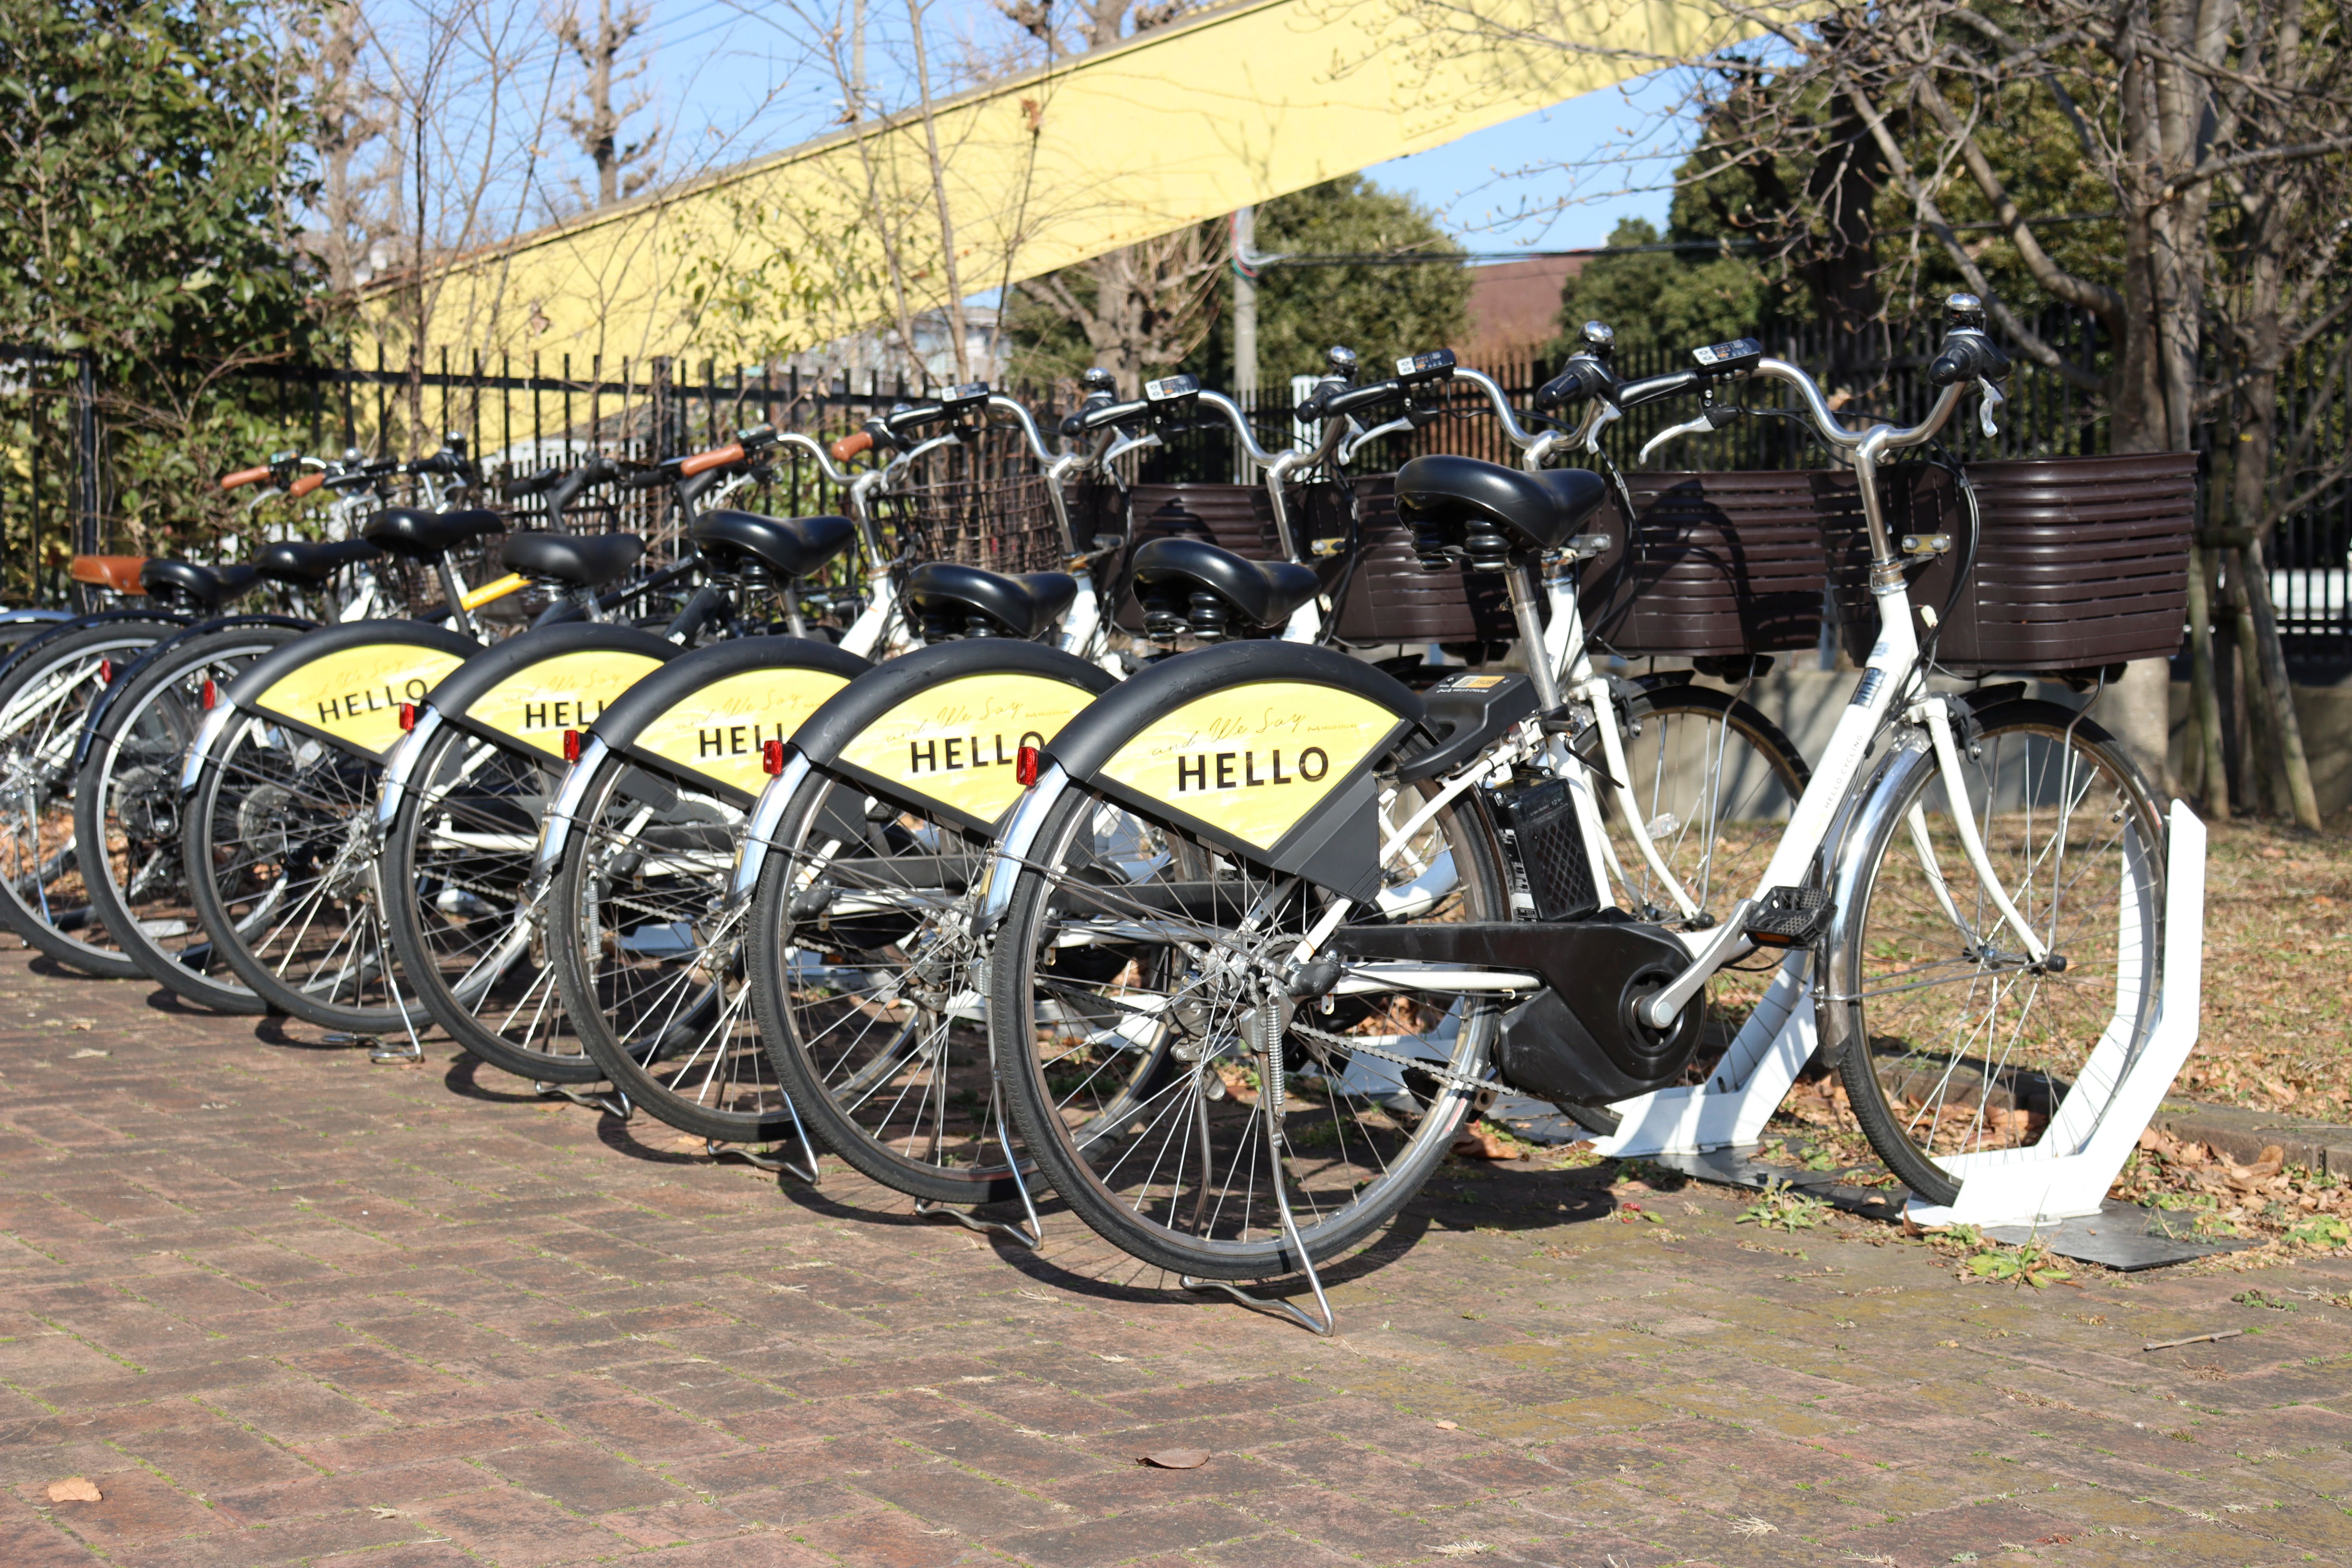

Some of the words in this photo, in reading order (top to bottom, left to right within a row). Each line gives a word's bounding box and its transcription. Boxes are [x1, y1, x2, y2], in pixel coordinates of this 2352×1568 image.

[318, 679, 427, 724] HELLO
[724, 697, 755, 718] We
[762, 689, 802, 710] Say
[887, 719, 928, 742] and
[937, 706, 972, 730] We
[979, 697, 1023, 720] Say
[1152, 731, 1198, 756] and
[1209, 717, 1247, 743] We
[1256, 708, 1306, 733] Say
[1178, 747, 1328, 791] HELLO
[1824, 777, 1842, 809] HELLO
[1841, 734, 1863, 775] CYCLING
